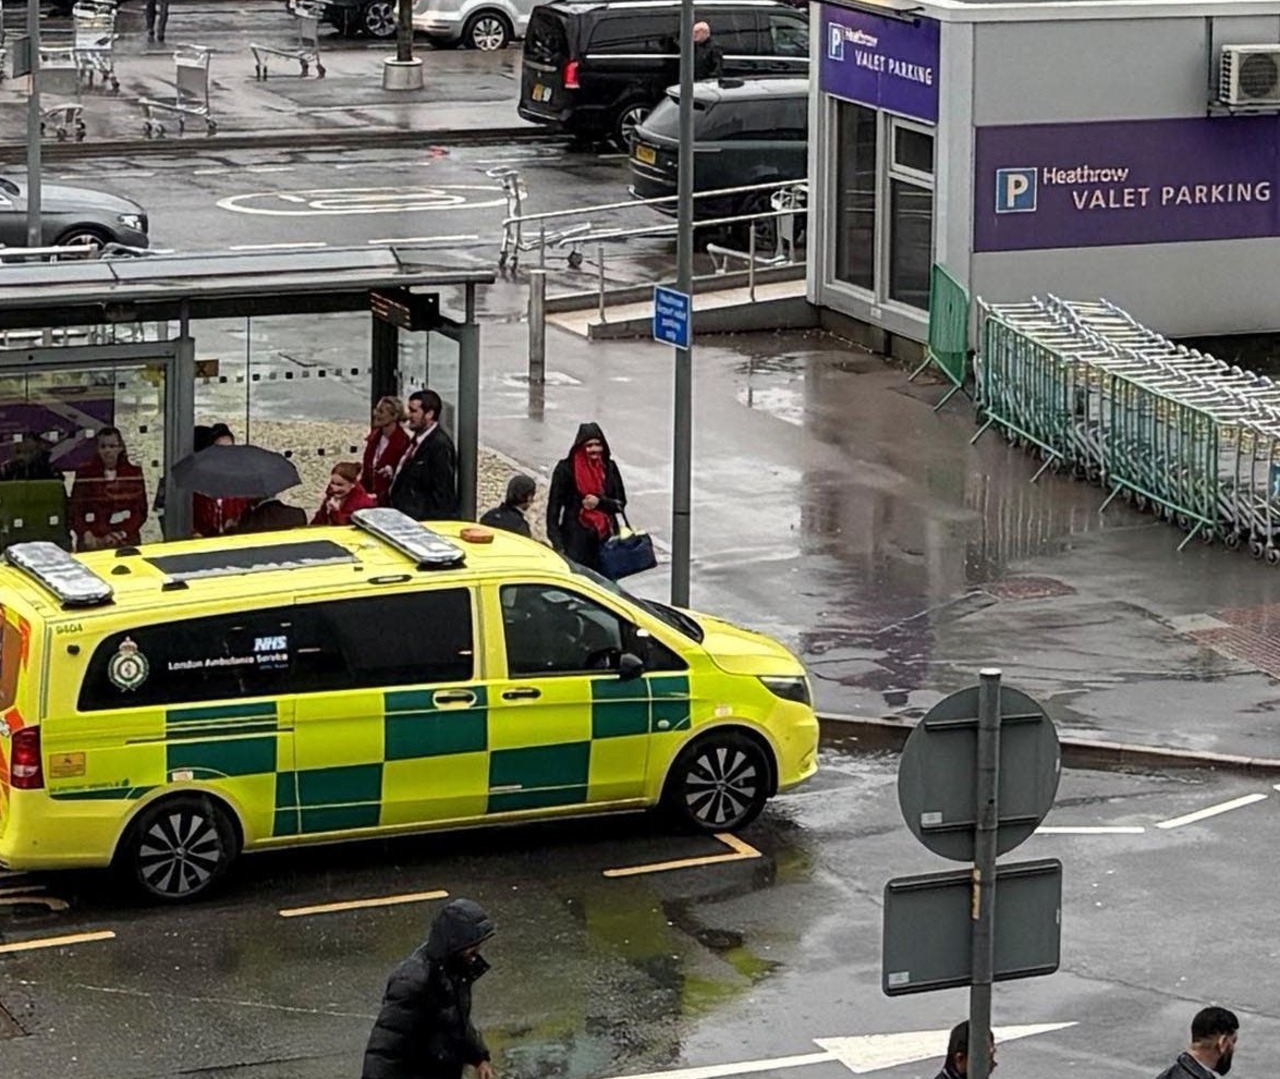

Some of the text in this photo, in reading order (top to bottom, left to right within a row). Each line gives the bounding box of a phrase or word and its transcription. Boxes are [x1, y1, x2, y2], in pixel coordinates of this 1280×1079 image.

[855, 49, 932, 85] VALET PARKING
[1043, 164, 1129, 185] Heathrow
[1073, 182, 1272, 210] VALET PARKING
[254, 635, 287, 652] NHS
[168, 660, 203, 671] London
[205, 656, 255, 668] Ambulance
[256, 653, 289, 663] Service
